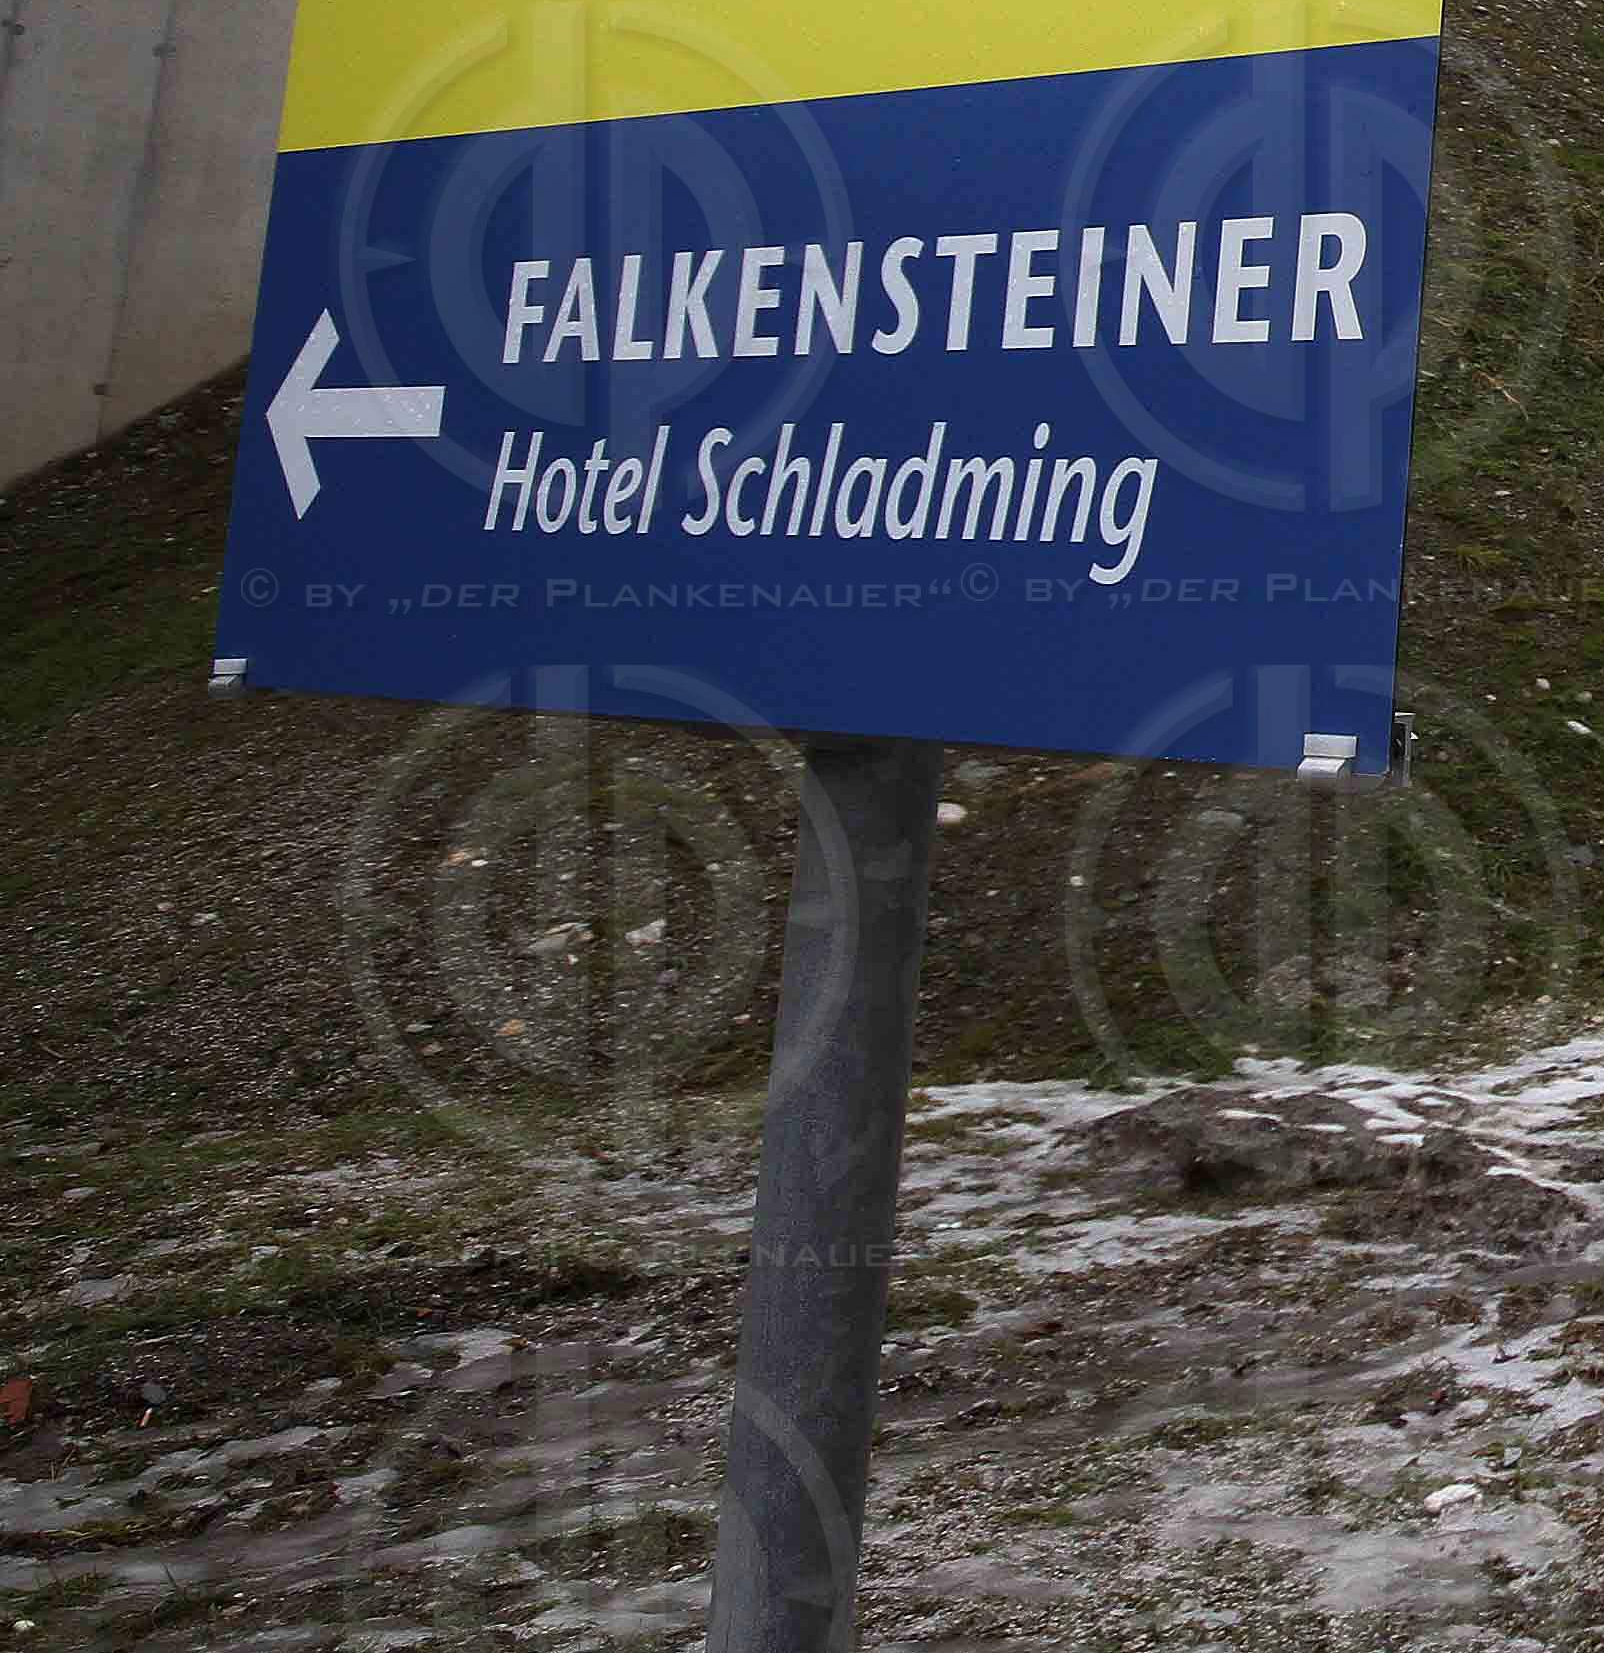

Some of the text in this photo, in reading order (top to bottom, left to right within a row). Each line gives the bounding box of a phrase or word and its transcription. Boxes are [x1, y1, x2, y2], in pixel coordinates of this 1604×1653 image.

[501, 210, 1369, 364] FALKENSTEINER
[483, 420, 1159, 586] Hotel Schladming
